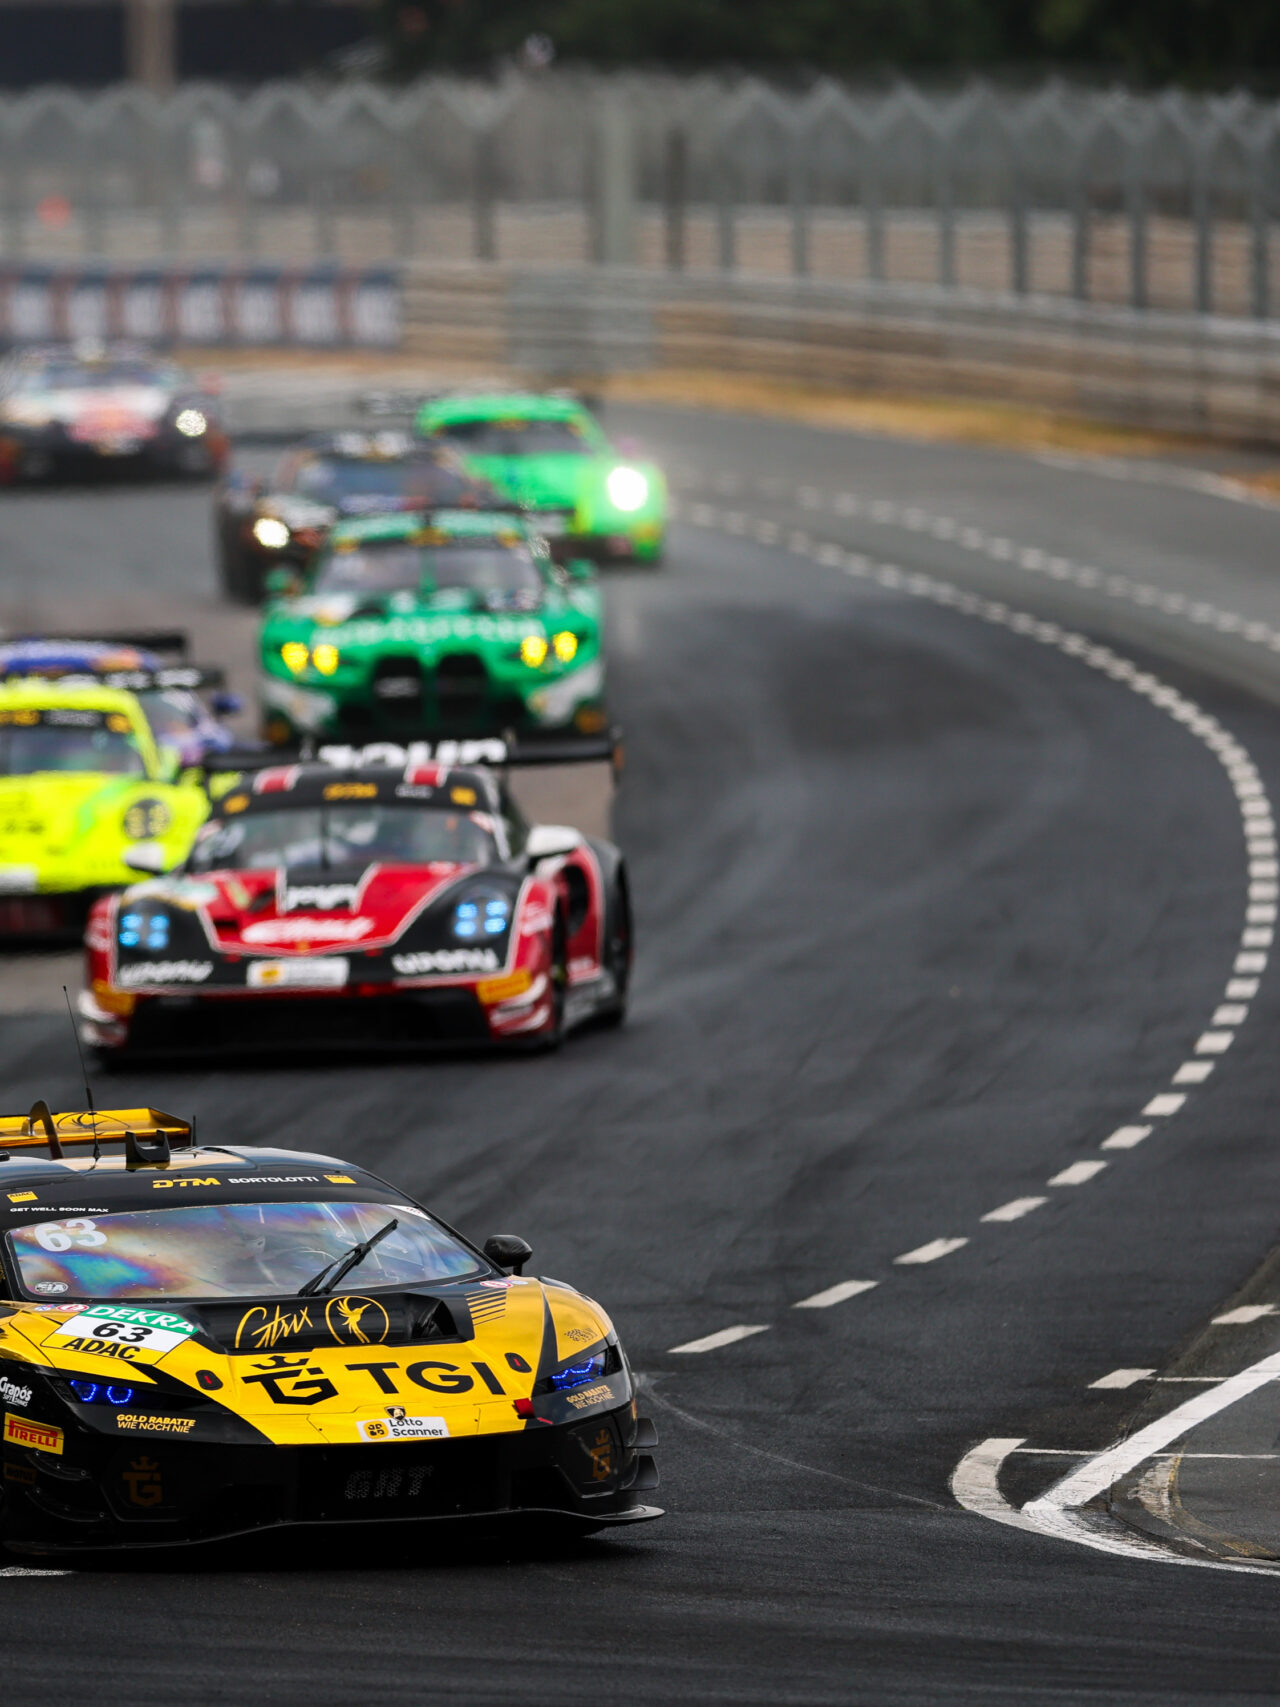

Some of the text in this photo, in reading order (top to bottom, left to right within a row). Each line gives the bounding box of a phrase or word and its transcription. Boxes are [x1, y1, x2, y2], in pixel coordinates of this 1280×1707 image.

[152, 1176, 319, 1189] DTM BORTOLOTTI
[34, 1219, 108, 1252] 63
[87, 1306, 195, 1333] DEKRA
[92, 1322, 153, 1343] 63
[62, 1337, 141, 1360] ADAC
[116, 1414, 196, 1427] GOLD RABATTE
[117, 1421, 191, 1433] WIE NOCH NIE
[388, 1419, 423, 1428] Lotto
[8, 1420, 58, 1447] PIRELLI
[392, 1428, 444, 1437] Scanner
